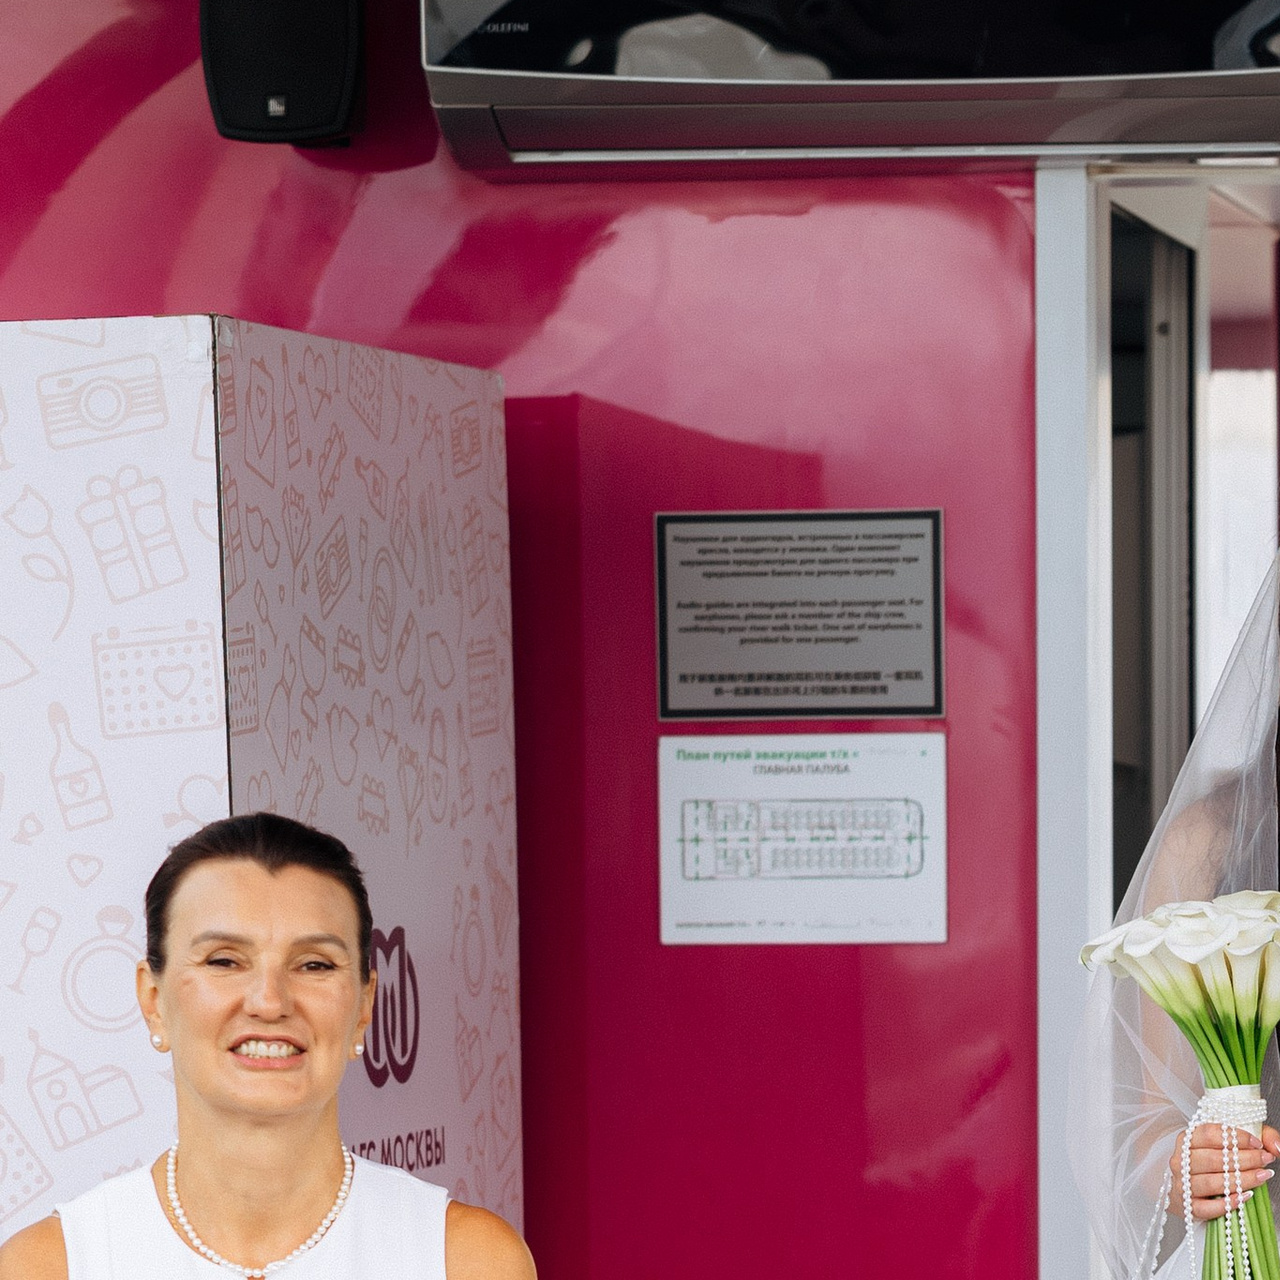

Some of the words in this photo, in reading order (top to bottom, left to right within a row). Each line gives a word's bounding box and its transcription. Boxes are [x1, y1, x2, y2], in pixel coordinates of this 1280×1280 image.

[676, 748, 710, 760] План
[712, 748, 752, 763] путей
[755, 750, 827, 762] эвакуации
[752, 764, 803, 775] ГЛАВНАЯ
[805, 763, 850, 774] ПАЛУБА
[381, 1126, 446, 1171] МОСКВЫ
